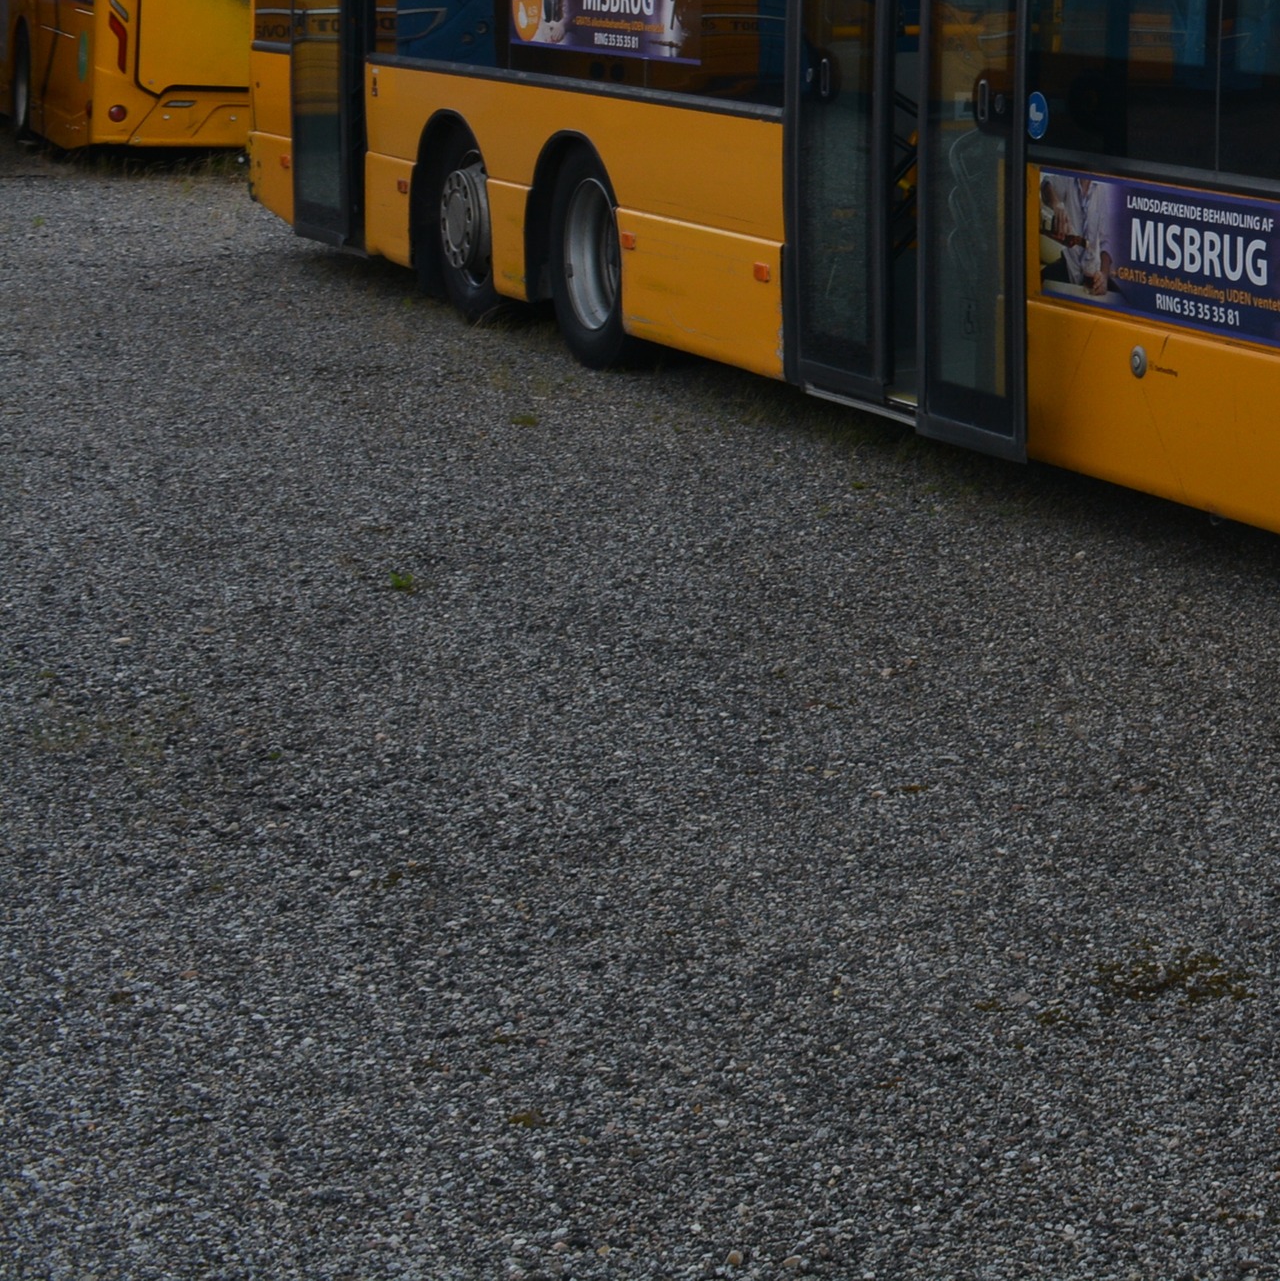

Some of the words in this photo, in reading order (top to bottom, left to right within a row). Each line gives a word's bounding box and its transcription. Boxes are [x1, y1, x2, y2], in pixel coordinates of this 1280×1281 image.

[1126, 195, 1202, 220] LANDSDÆKKENDE
[1202, 205, 1261, 230] BEHANDLING
[1262, 217, 1274, 232] AF
[1131, 218, 1267, 287] MISBRUG
[1118, 267, 1147, 285] GRATIS
[1148, 275, 1225, 305] alkoholbehandling
[1226, 289, 1251, 306] UDEN
[1155, 293, 1182, 316] RING
[1183, 299, 1196, 319] 35
[1198, 302, 1211, 321] 35
[1212, 305, 1226, 324] 35
[1227, 309, 1239, 326] 81
